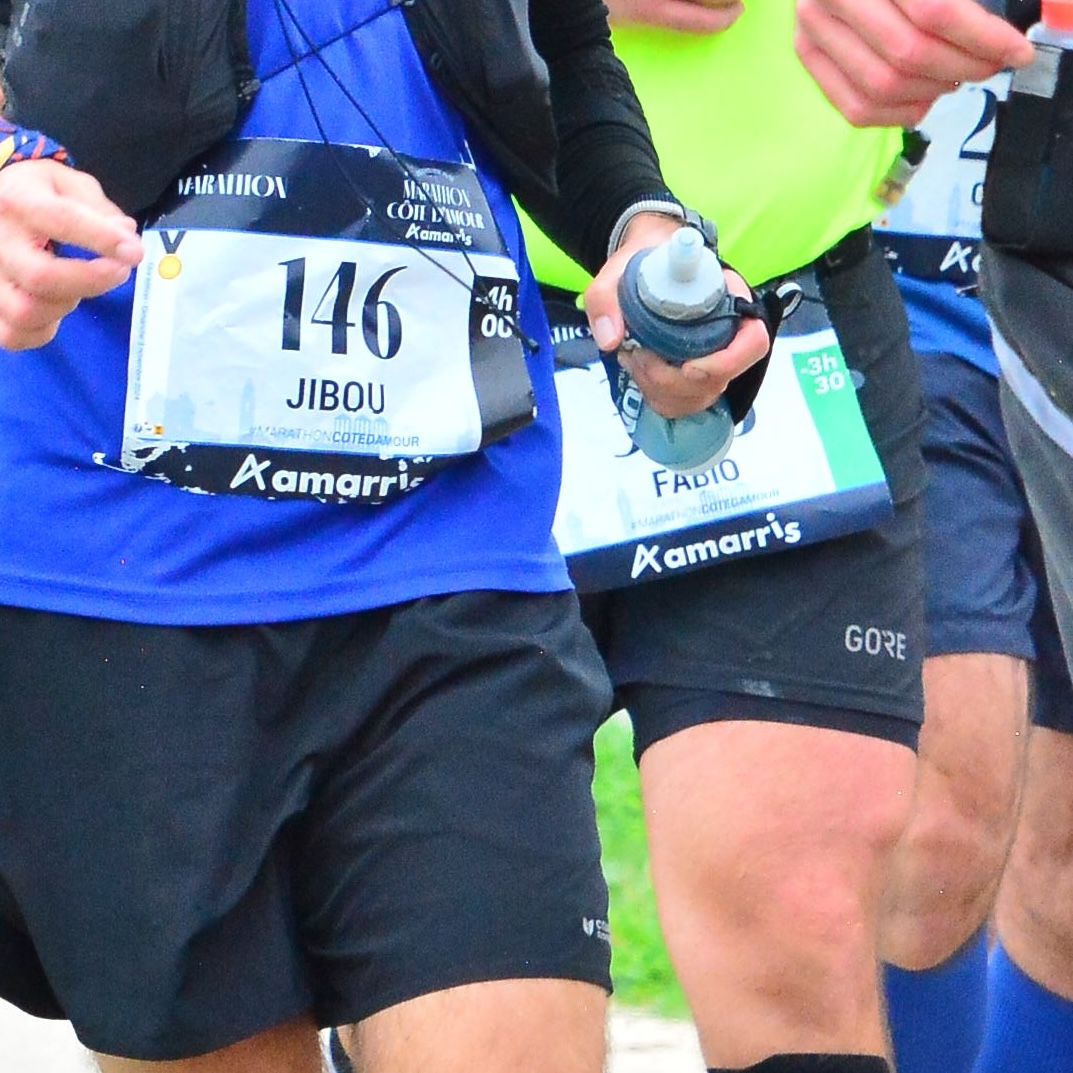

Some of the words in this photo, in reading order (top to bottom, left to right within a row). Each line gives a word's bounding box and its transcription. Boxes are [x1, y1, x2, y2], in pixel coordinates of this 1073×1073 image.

[277, 256, 408, 360] 146
[286, 378, 385, 414] JIBOU
[814, 371, 845, 395] 30
[652, 459, 740, 498] FABIO
[664, 512, 802, 569] amarris
[845, 625, 907, 661] GORE
